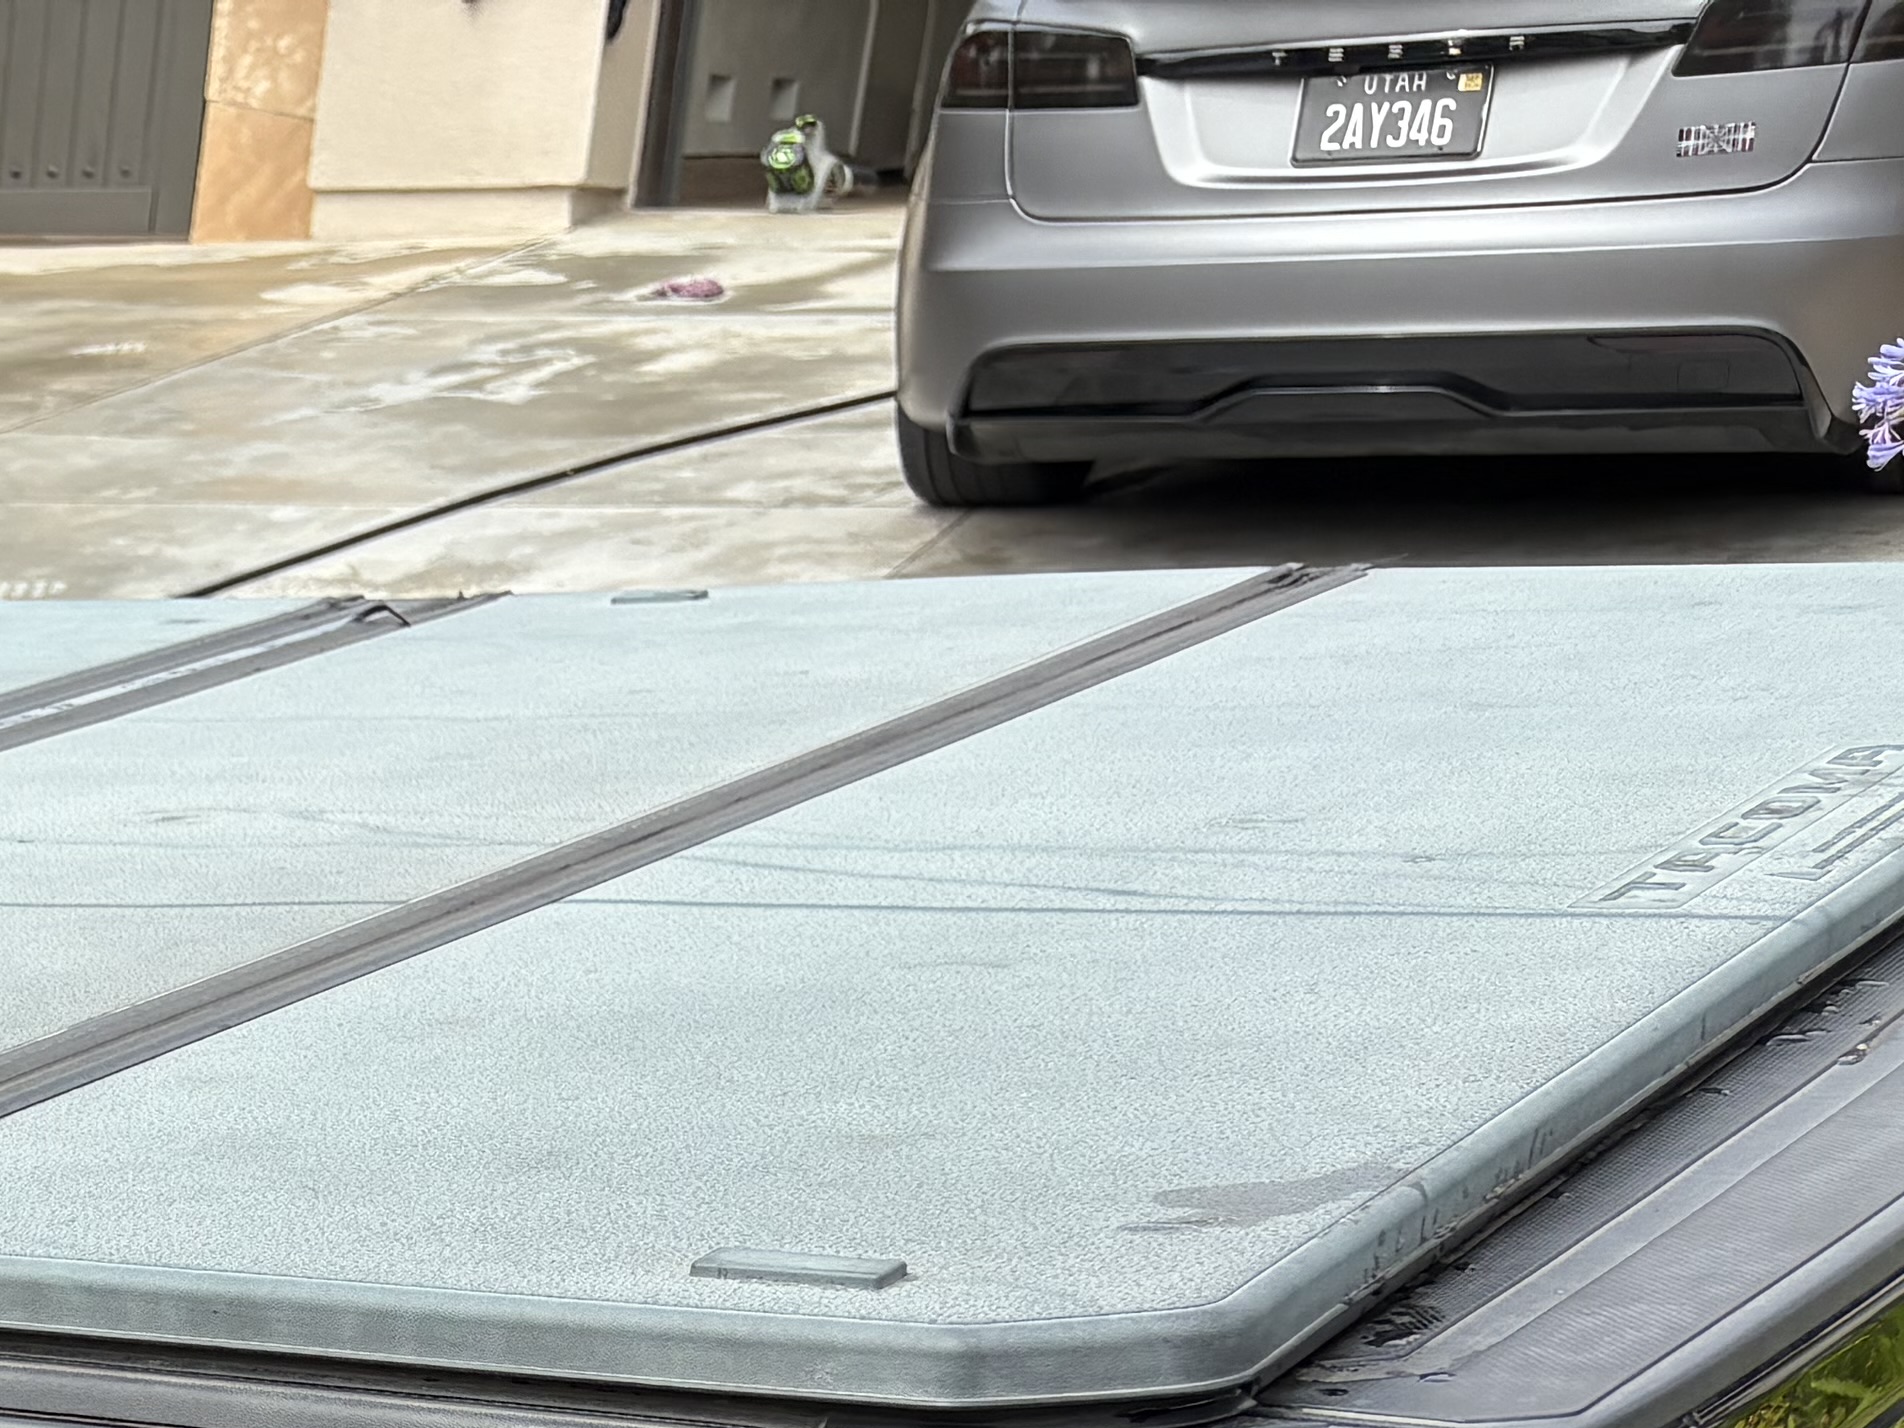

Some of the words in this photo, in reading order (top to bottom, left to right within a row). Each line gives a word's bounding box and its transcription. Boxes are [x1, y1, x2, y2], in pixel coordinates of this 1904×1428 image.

[1363, 70, 1428, 95] UTAH
[1319, 97, 1457, 150] 2AY346
[1597, 742, 1904, 902] TACOMA
